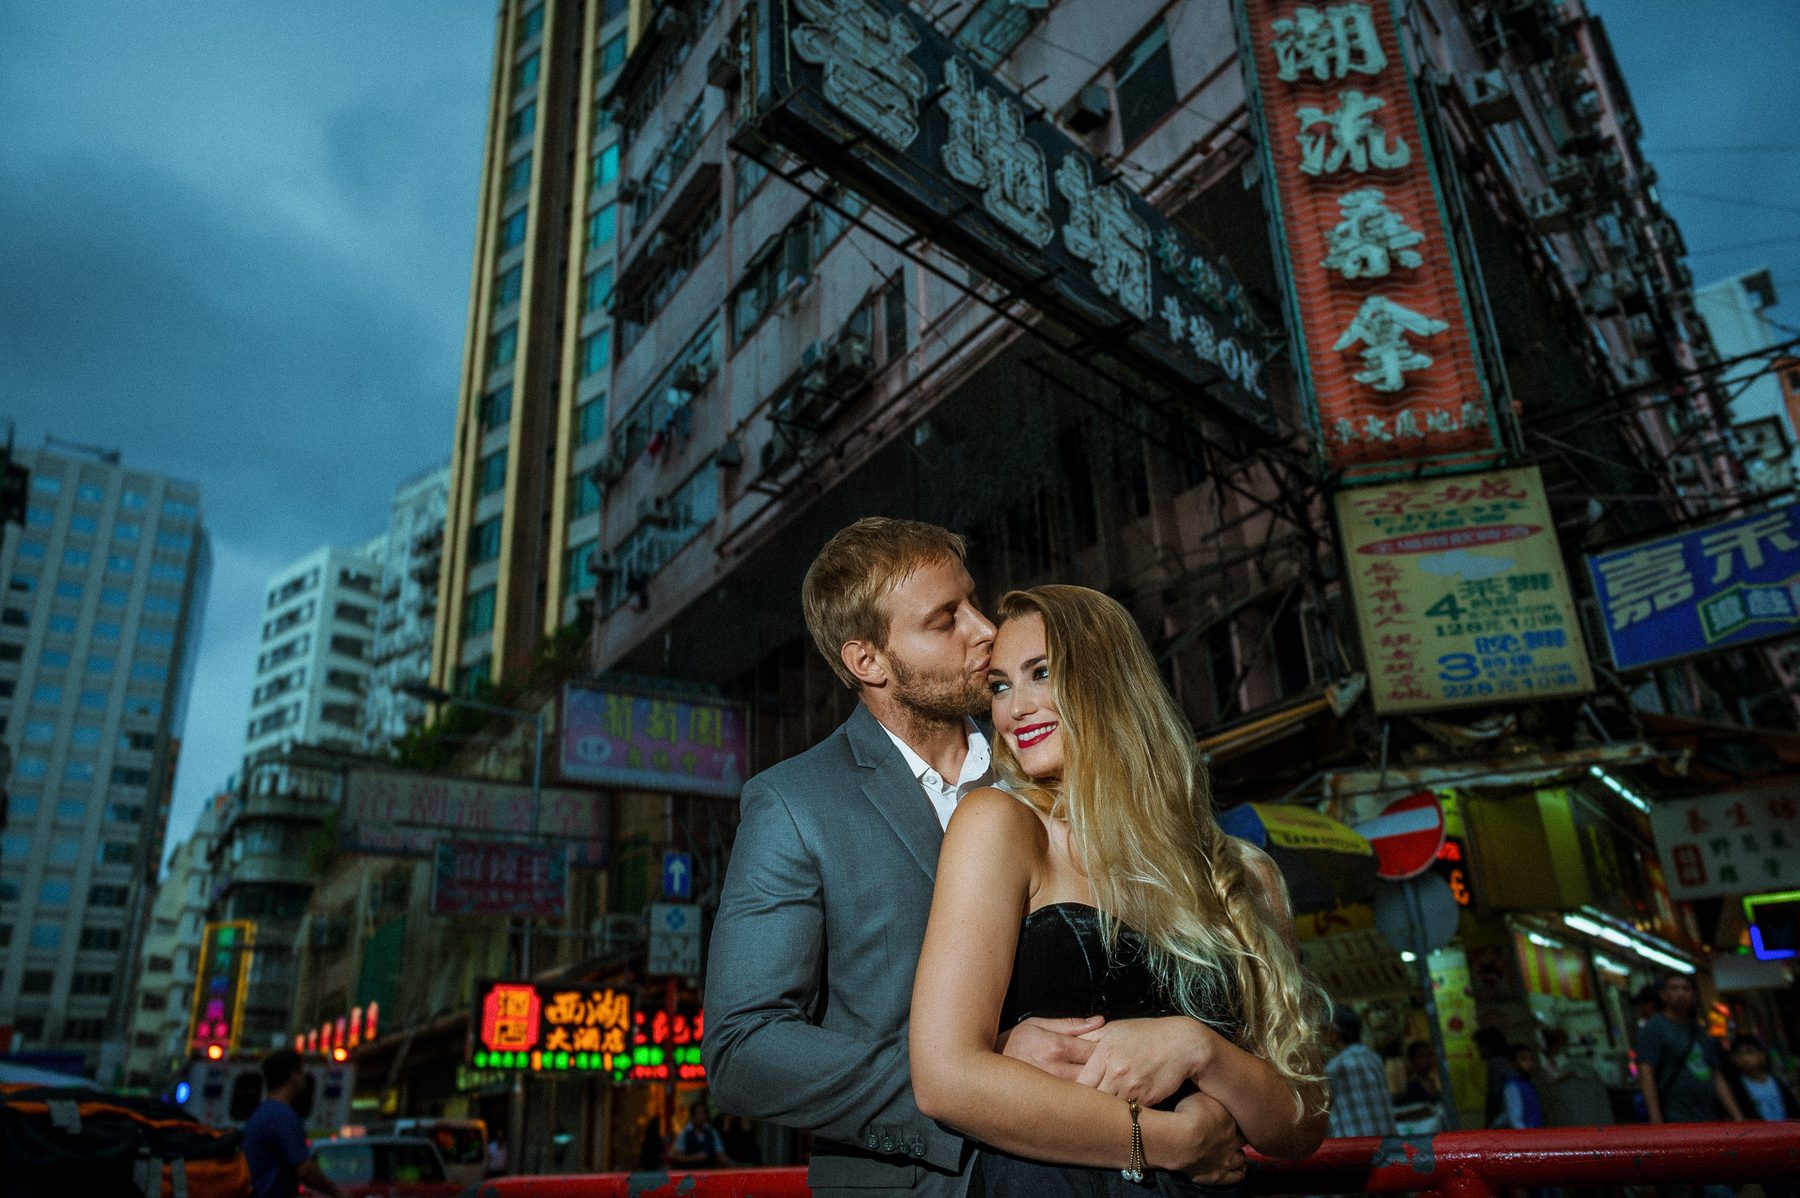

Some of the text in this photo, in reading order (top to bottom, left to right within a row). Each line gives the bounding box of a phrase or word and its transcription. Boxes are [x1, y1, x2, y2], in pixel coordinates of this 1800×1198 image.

[1270, 3, 1449, 393] 潮流桑拿
[1598, 513, 1800, 632] 嘉禾
[1425, 594, 1466, 620] 4
[1438, 652, 1480, 681] 3
[494, 989, 532, 1046] 酒店
[545, 987, 630, 1031] 西湖
[545, 1026, 627, 1053] 大酒店
